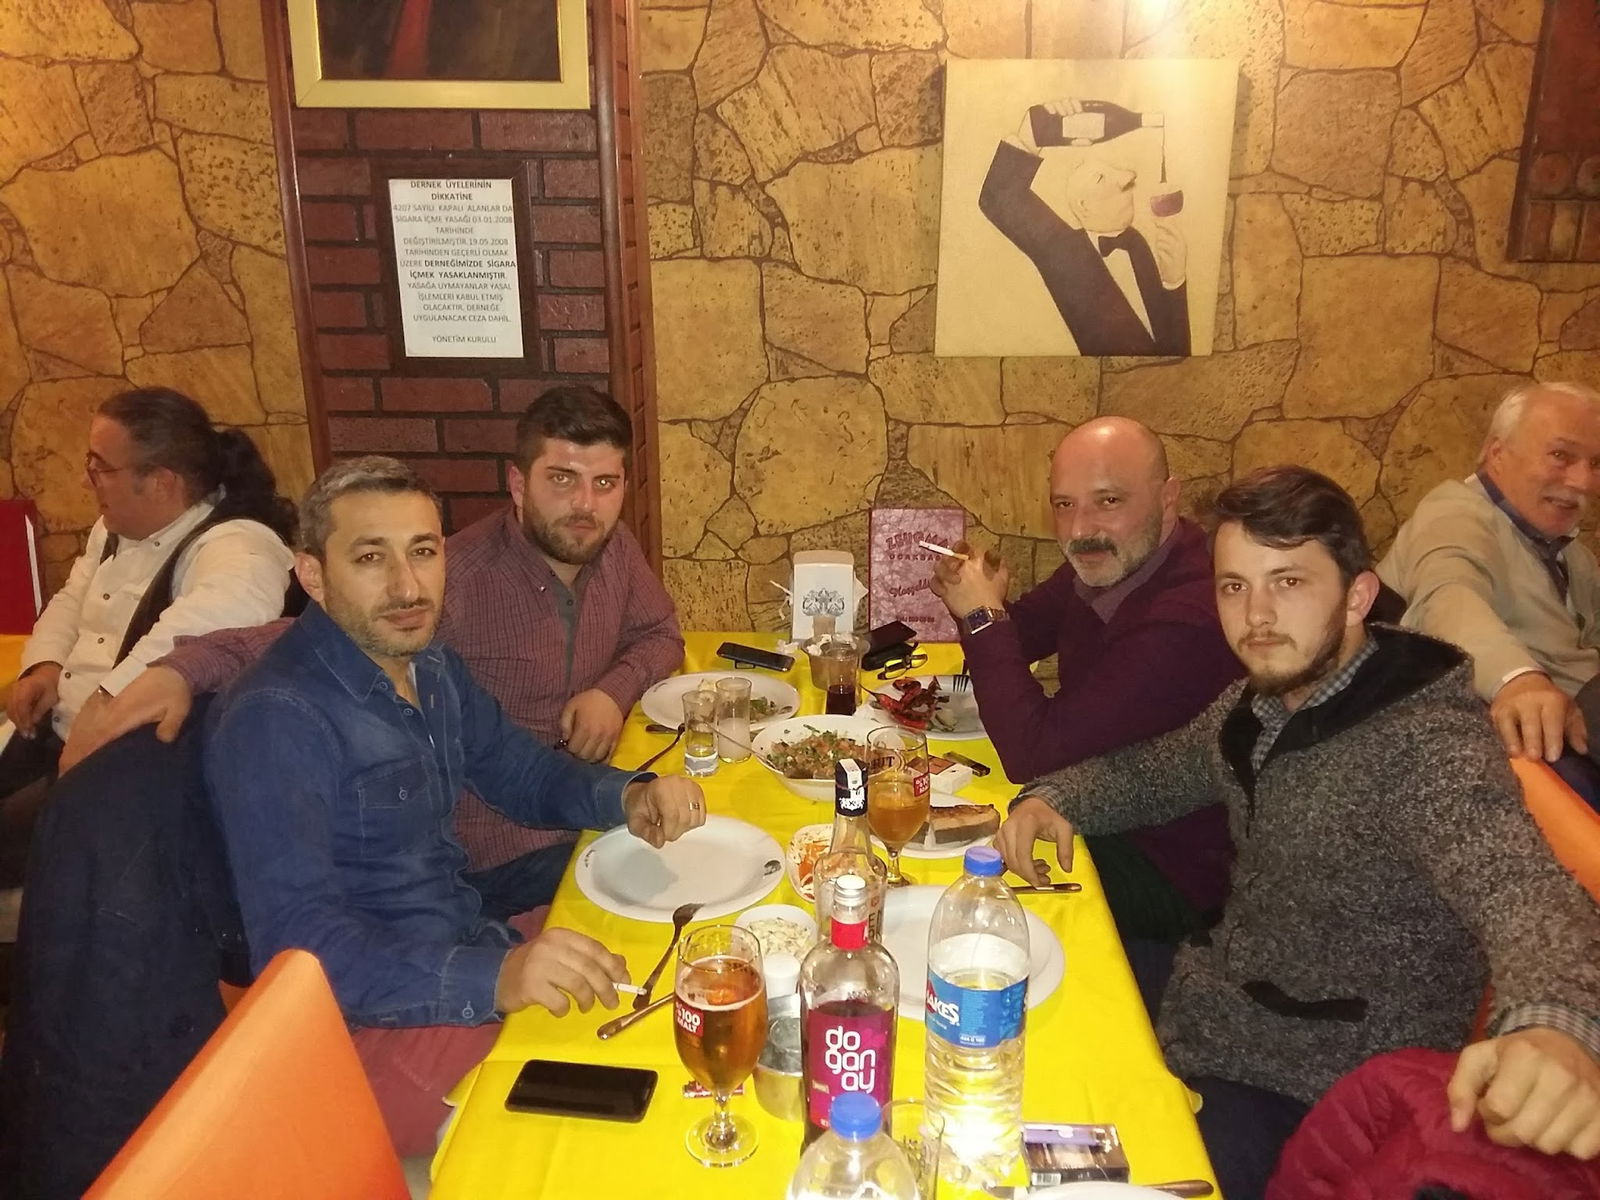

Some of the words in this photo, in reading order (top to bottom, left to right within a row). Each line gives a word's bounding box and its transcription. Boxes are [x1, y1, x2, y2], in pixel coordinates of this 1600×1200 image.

[410, 181, 441, 189] DERNEK
[445, 180, 492, 189] ÜYELERİNİN
[431, 192, 473, 201] DİKKATİNE
[438, 204, 464, 212] KAPALI
[466, 204, 501, 213] ALANLAR
[502, 204, 512, 213] DA
[445, 214, 471, 223] YASAĞI
[482, 249, 509, 257] OLMAK
[424, 258, 484, 268] DERNEĞİMİZDE
[487, 258, 517, 268] SİGARA
[409, 270, 435, 280] İÇMEK
[407, 281, 436, 289] YASAĞA
[438, 282, 489, 290] UYMAYANLAR
[490, 282, 512, 290] YASAL
[456, 293, 479, 301] KABUL
[481, 293, 504, 303] ETMİŞ
[466, 303, 500, 312] DERNEĞE
[412, 314, 467, 323] UYGULANACAK
[468, 314, 487, 323] CEZA
[432, 334, 466, 344] YÖNETİM
[467, 335, 497, 344] KURULU
